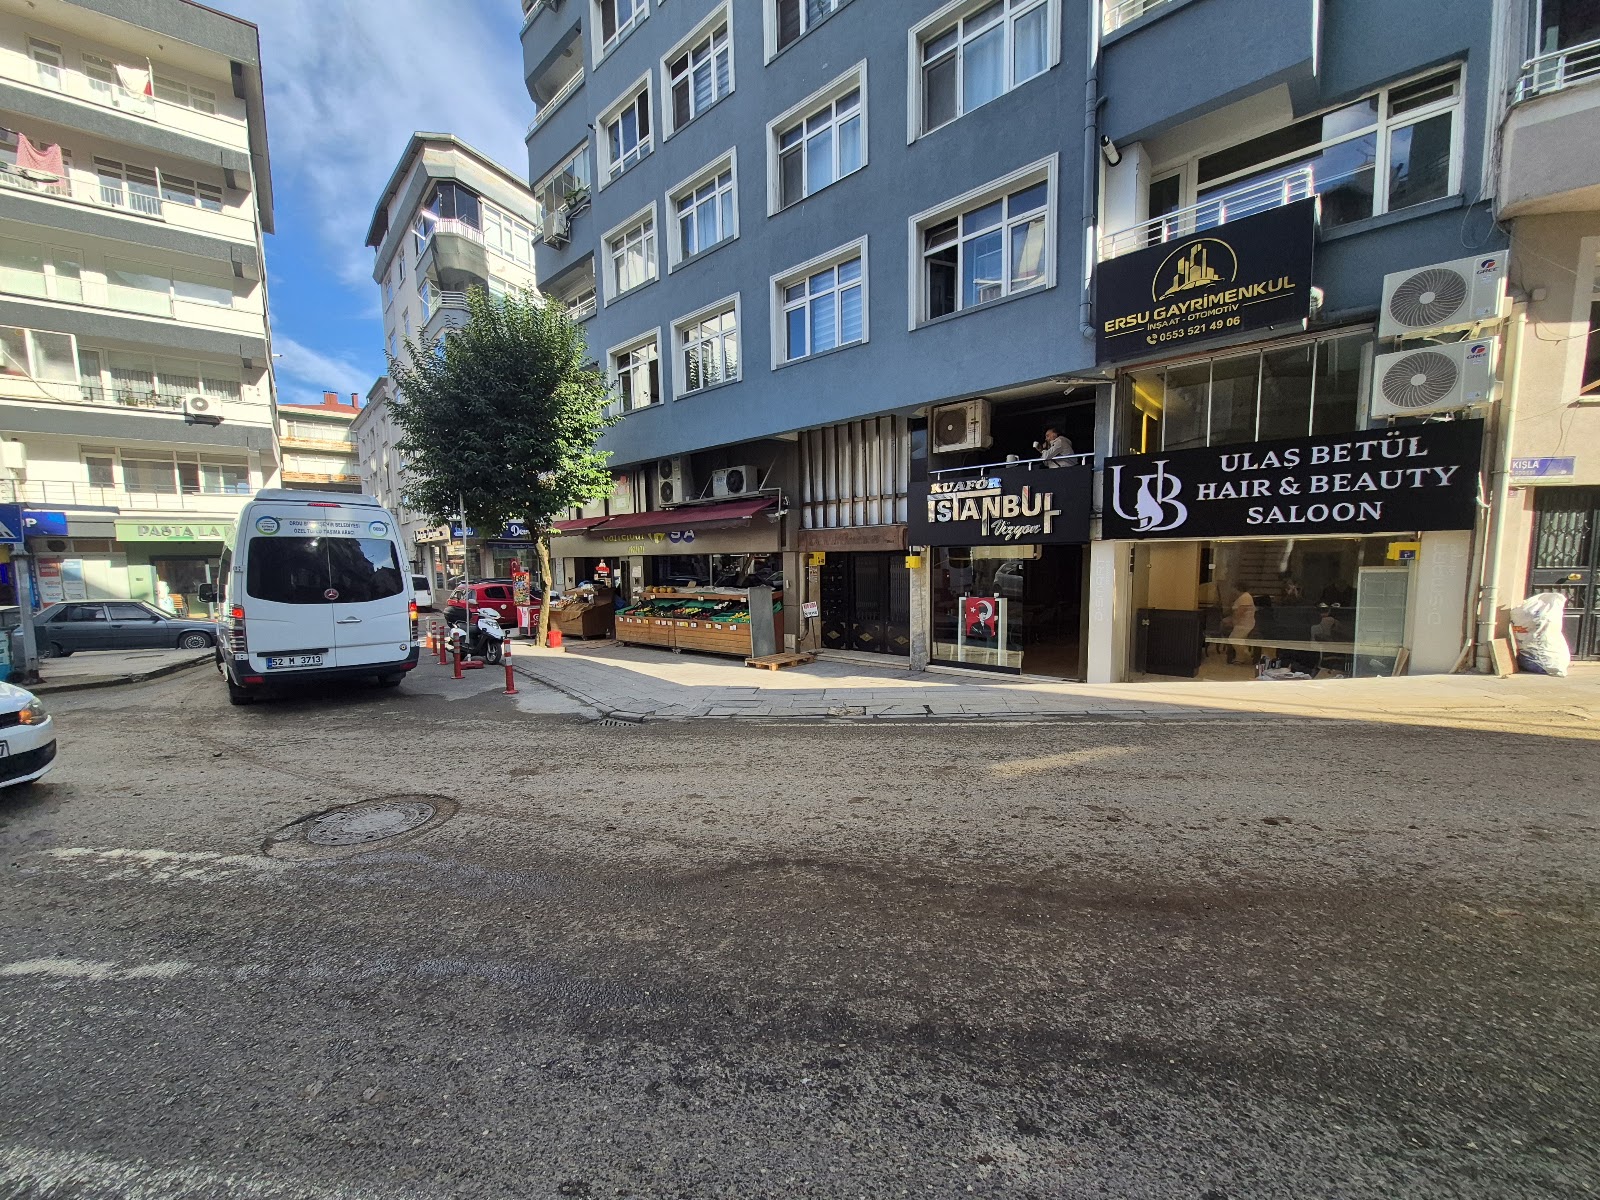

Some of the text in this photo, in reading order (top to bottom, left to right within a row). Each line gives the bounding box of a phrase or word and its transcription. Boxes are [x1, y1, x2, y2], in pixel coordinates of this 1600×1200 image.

[1104, 275, 1296, 333] ERSU GAYRİMENKUL
[1147, 317, 1181, 331] İNŞAAT
[1187, 303, 1239, 322] OTOMOTİV
[1159, 316, 1241, 342] 0553 521 49 06
[1220, 431, 1428, 473] ULAŞ BETÜL
[1512, 460, 1539, 470] KIŞLA
[930, 476, 1002, 494] KUAFÖR
[1196, 465, 1461, 502] HAIR & BEAUTY
[1246, 501, 1383, 525] SALOON
[138, 525, 194, 537] PASTA
[198, 525, 221, 537] LA
[272, 658, 284, 666] 52
[300, 655, 321, 664] 3713
